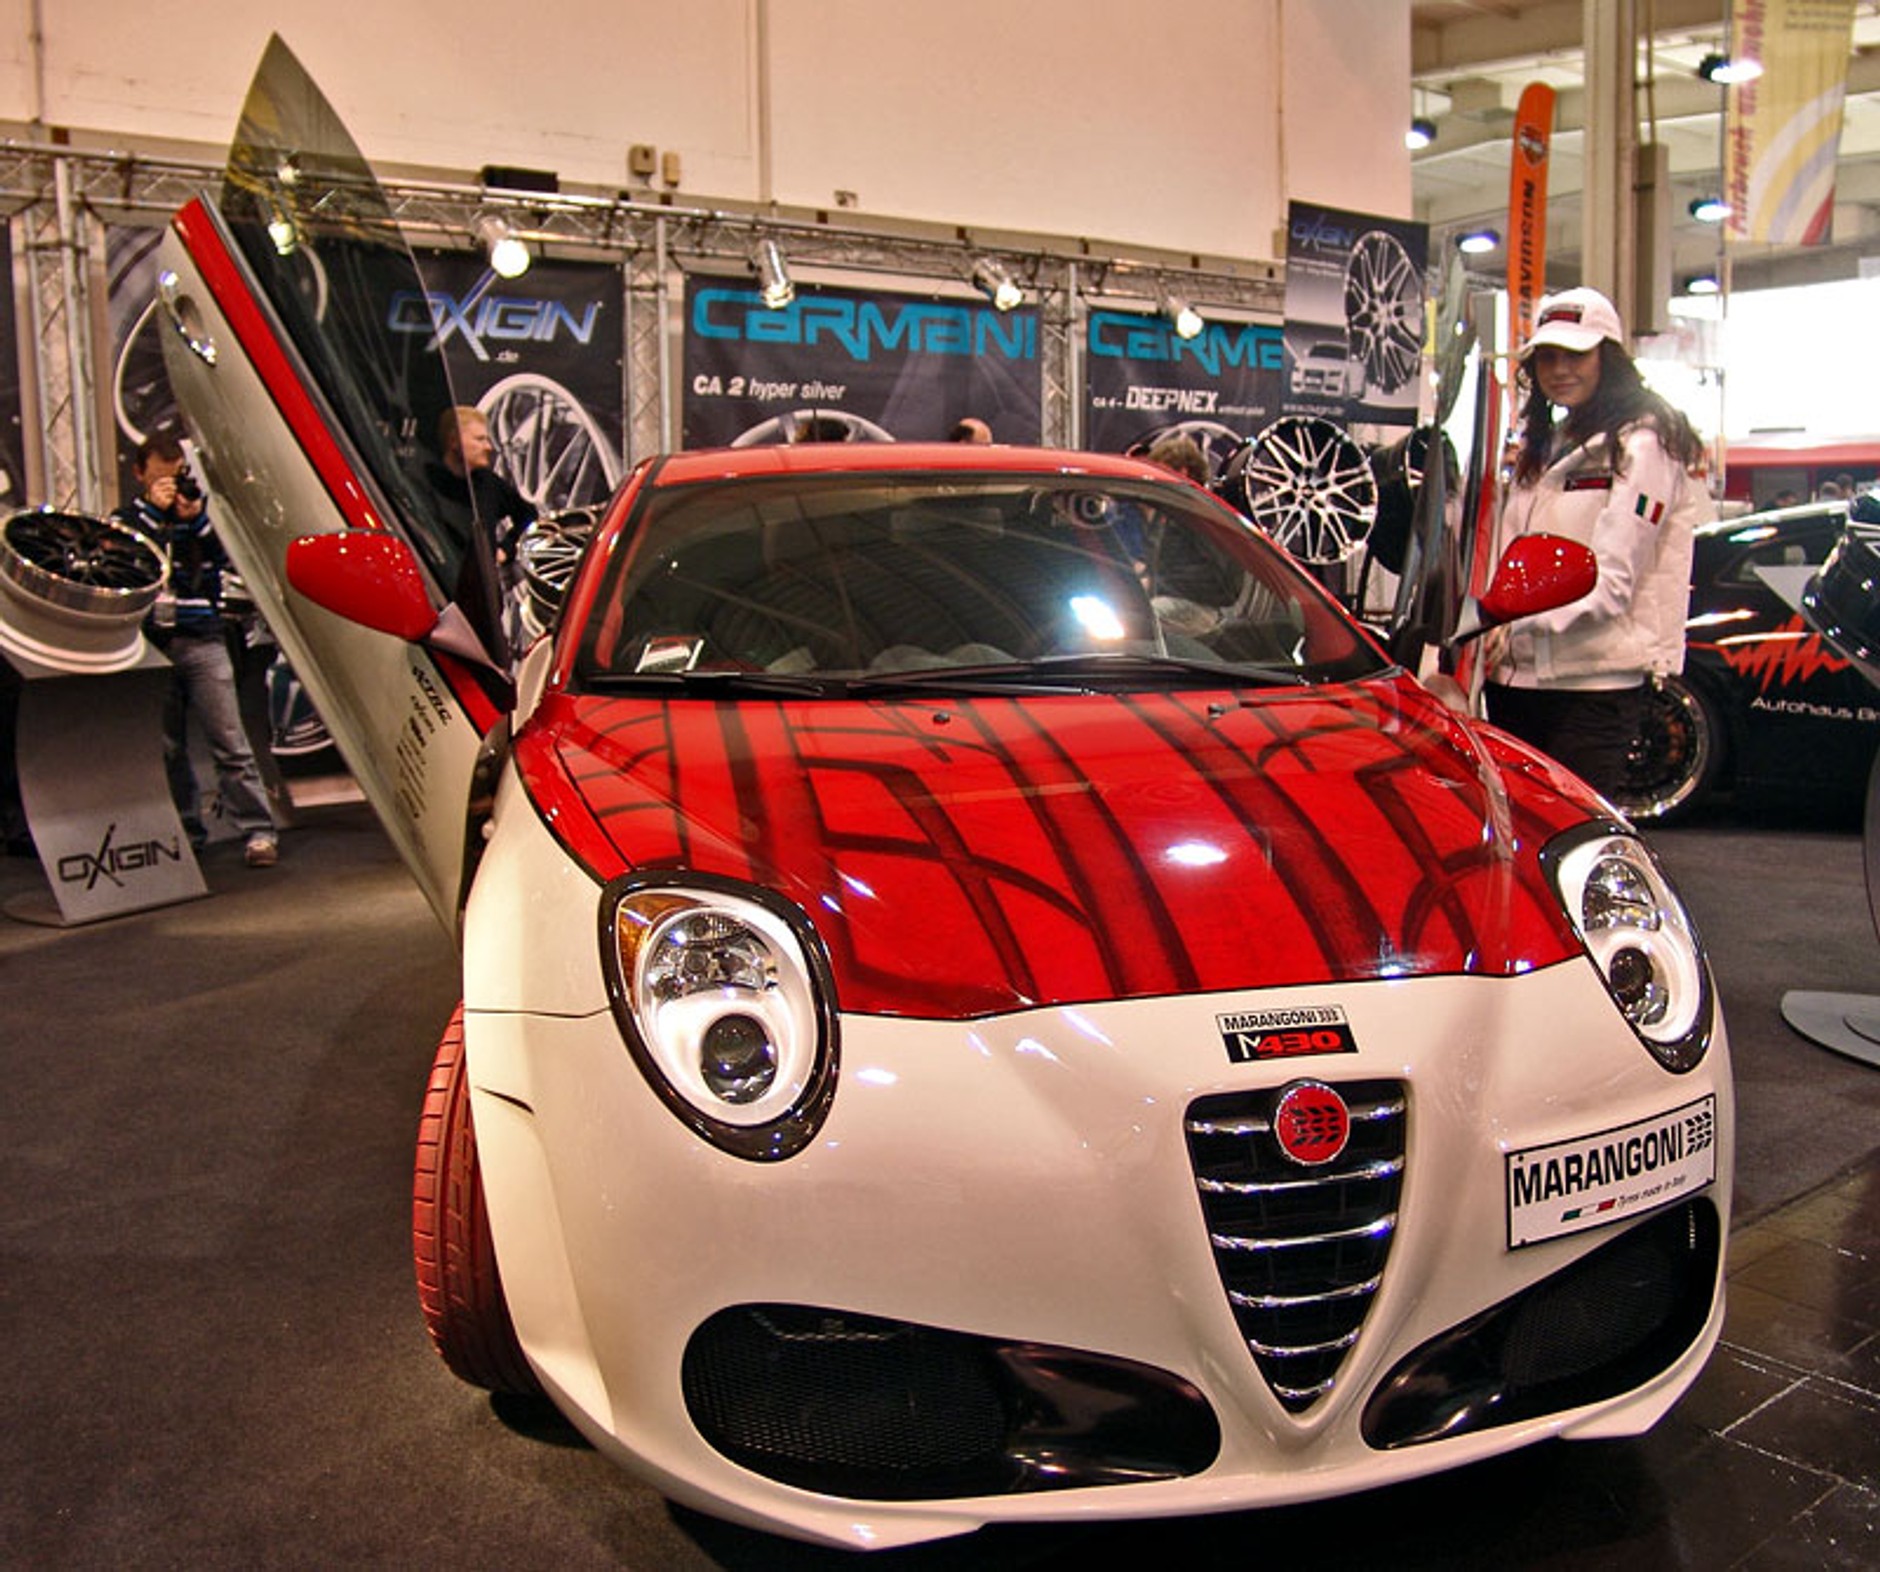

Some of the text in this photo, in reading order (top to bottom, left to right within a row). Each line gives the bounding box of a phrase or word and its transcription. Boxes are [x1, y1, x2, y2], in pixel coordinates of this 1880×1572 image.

[388, 268, 599, 361] OXIGIN
[692, 288, 1036, 362] CARMANI
[693, 375, 846, 400] CA 2 hyper silver
[1126, 386, 1219, 414] DEEPNEX
[1751, 695, 1853, 720] Autohaus
[58, 823, 180, 890] OXIGIN
[1224, 1010, 1317, 1031] MARANGONI
[1513, 1122, 1684, 1208] MARANGONI
